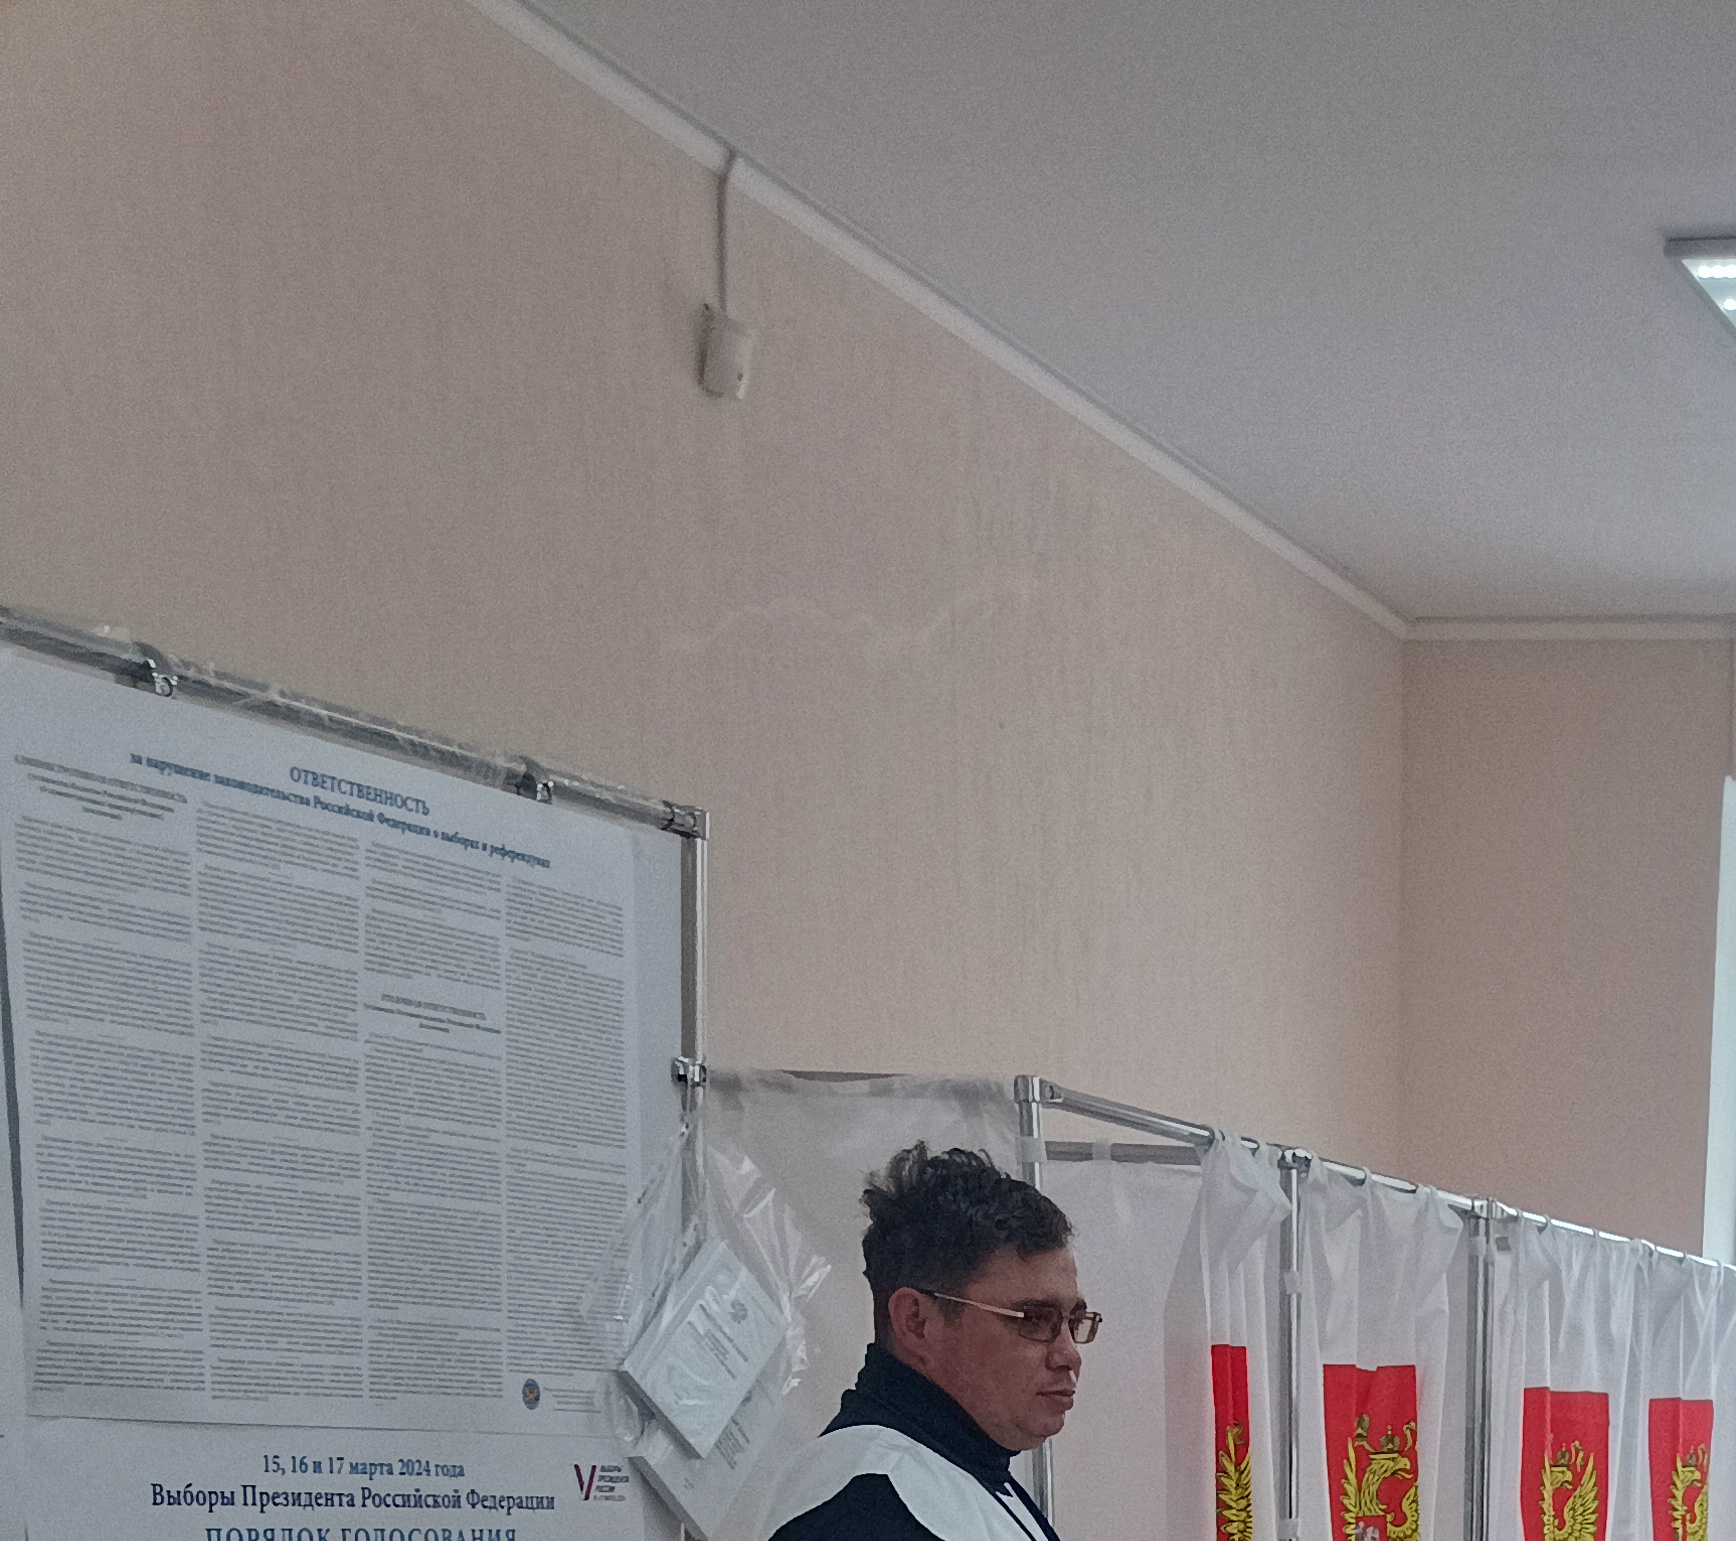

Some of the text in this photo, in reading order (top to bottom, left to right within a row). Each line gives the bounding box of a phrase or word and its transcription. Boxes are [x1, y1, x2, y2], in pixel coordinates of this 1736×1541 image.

[289, 766, 430, 816] ОТВЕТСТВЕННОСТЬ
[263, 1455, 465, 1480] 15, 16 и 17 марта 2024 года
[151, 1483, 555, 1515] Выборы Президента Российской Федерации
